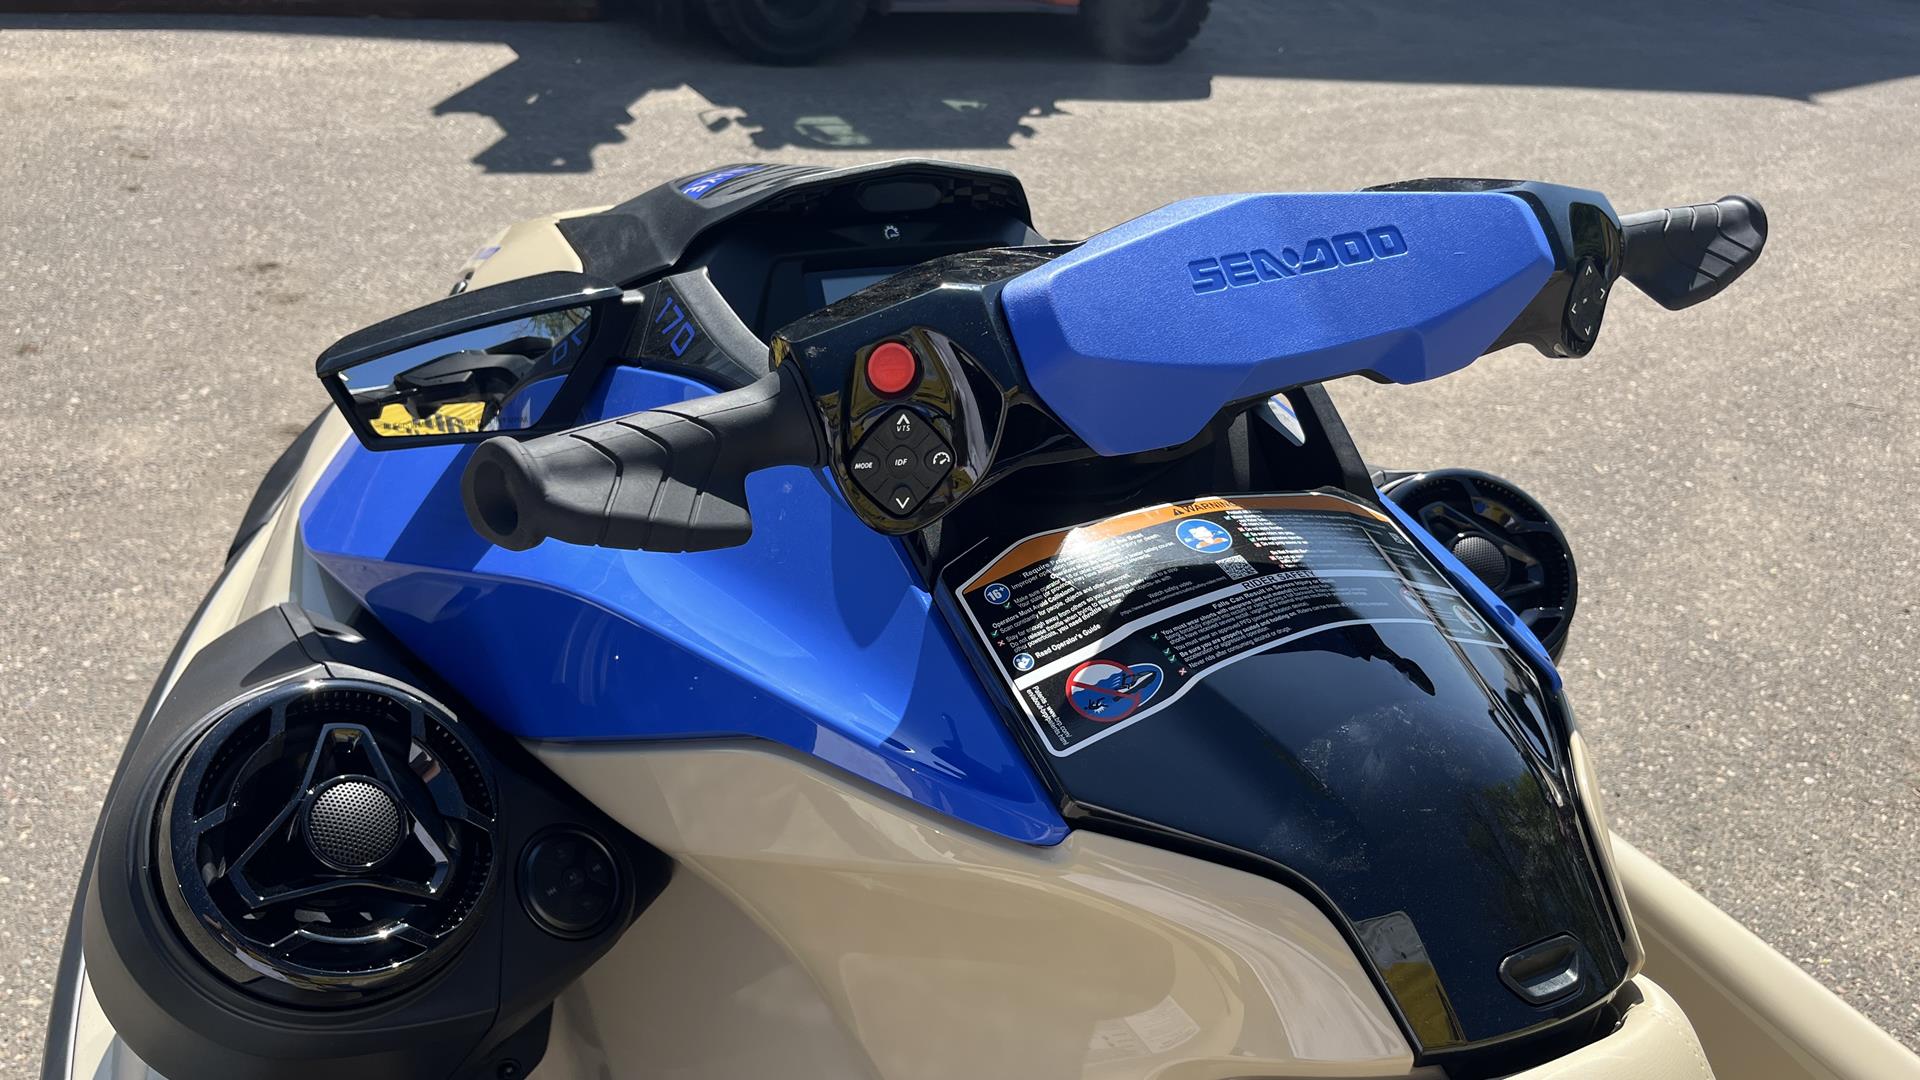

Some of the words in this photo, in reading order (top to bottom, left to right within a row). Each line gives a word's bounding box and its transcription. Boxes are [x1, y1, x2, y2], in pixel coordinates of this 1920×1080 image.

[655, 296, 695, 357] 170
[854, 462, 873, 470] MODE
[894, 458, 908, 466] IDF
[1022, 562, 1050, 578] Require
[1011, 574, 1038, 590] Improper
[1242, 576, 1276, 590] RIDER
[1277, 570, 1316, 581] SAFETY
[986, 586, 1005, 601] 16+
[1212, 600, 1230, 610] Falls
[1230, 596, 1244, 604] Can
[1243, 588, 1266, 598] Result
[1272, 582, 1296, 590] Severe
[992, 614, 1020, 628] Operators
[1018, 607, 1034, 617] Must
[1032, 599, 1049, 610] Avoid
[1048, 586, 1075, 603] Collisions
[1000, 624, 1014, 634] Scan
[1172, 622, 1188, 632] must
[1184, 638, 1199, 647] must
[1239, 618, 1252, 626] PFD
[1034, 646, 1053, 659] Read
[1051, 633, 1084, 652] Operator's
[1082, 624, 1101, 636] Guide
[1188, 646, 1201, 654] sure
[1200, 642, 1212, 650] you
[1188, 658, 1206, 668] Never
[1032, 685, 1048, 704] Patents
